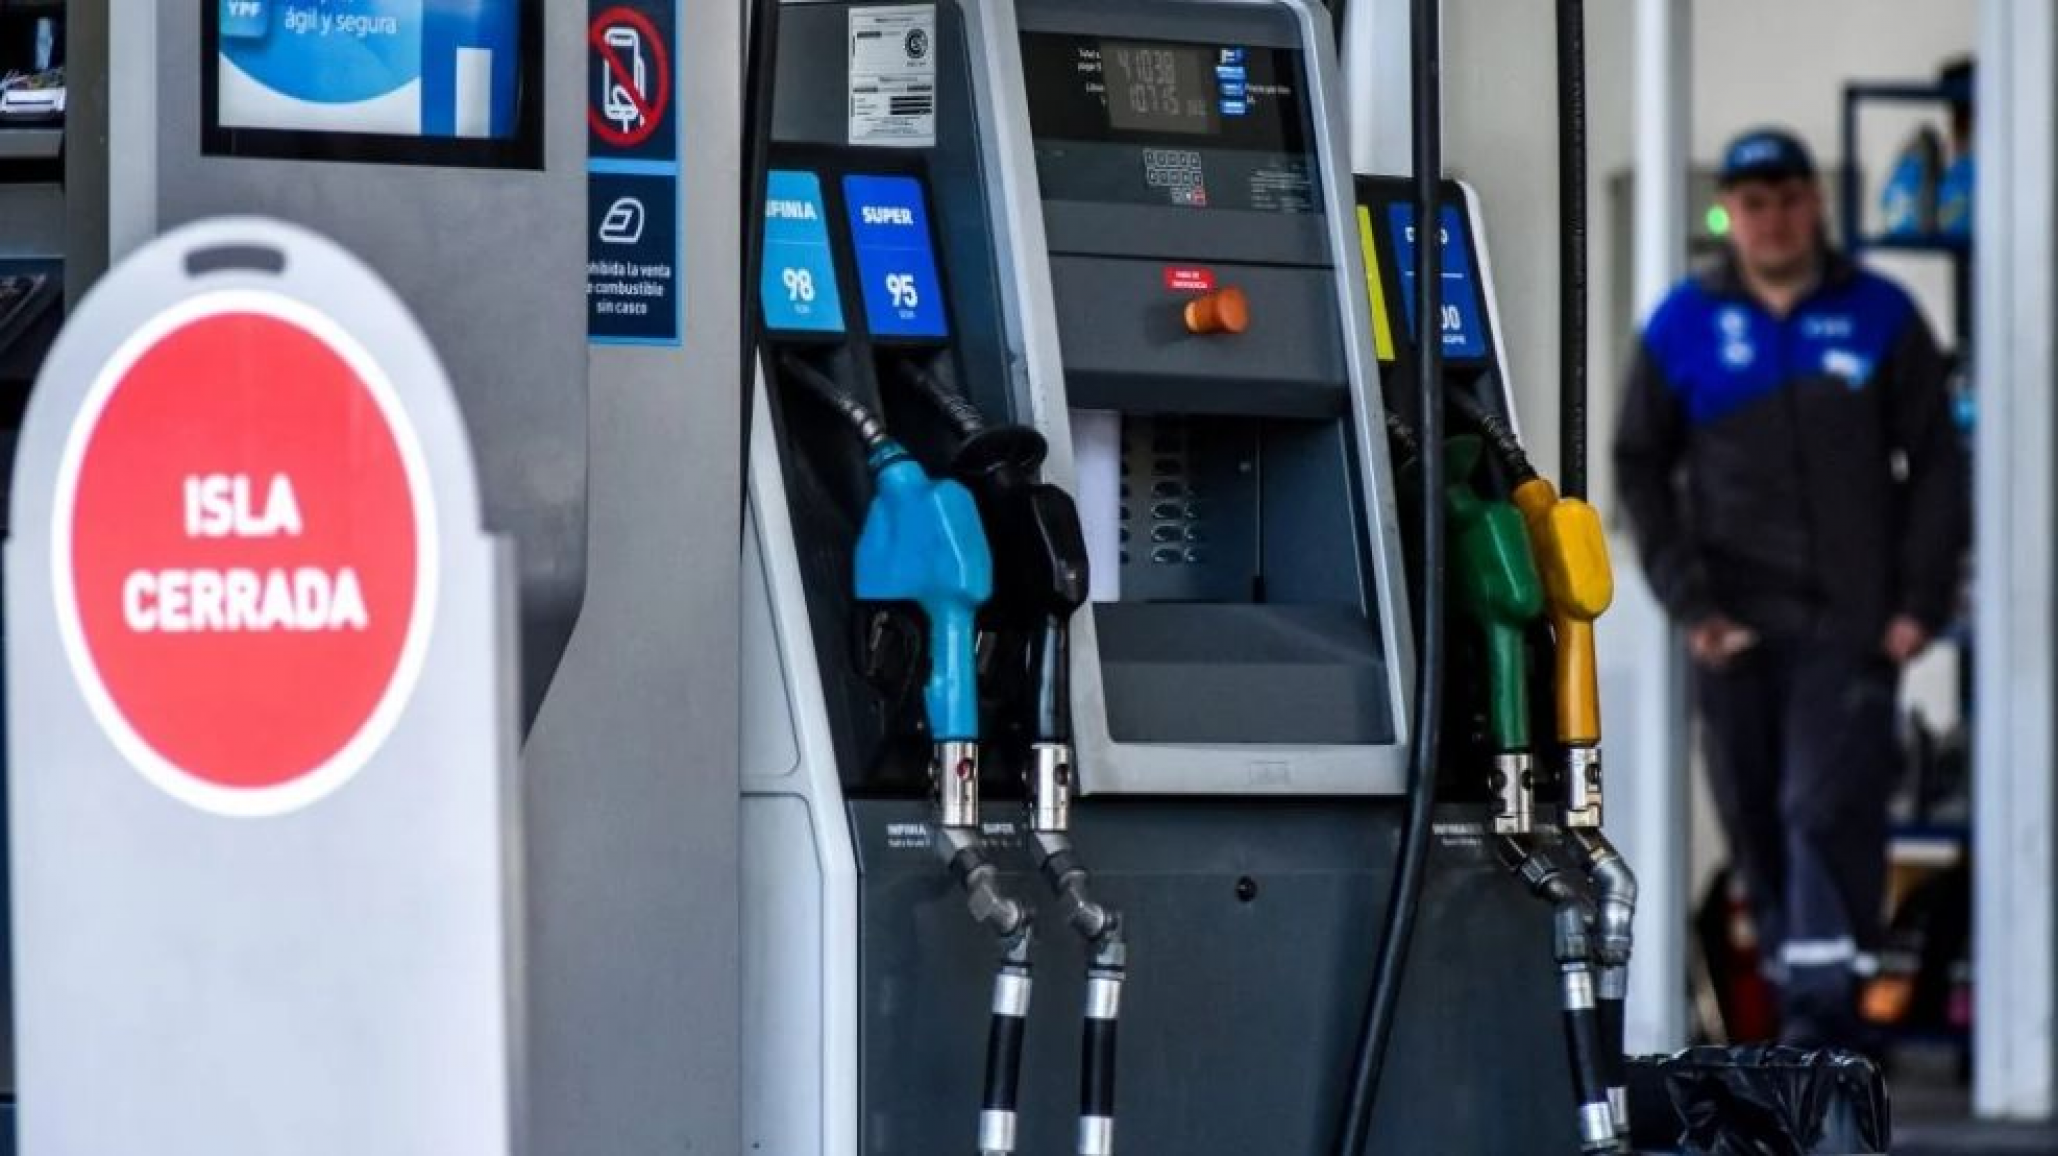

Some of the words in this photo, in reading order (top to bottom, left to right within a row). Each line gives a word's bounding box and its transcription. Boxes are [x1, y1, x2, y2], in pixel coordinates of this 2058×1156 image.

[285, 7, 318, 34] ágil
[320, 14, 332, 36] y
[336, 16, 398, 37] segura
[862, 206, 914, 225] SUPER
[627, 261, 639, 275] la
[641, 264, 671, 278] venta
[783, 267, 815, 301] 98
[596, 281, 664, 296] combustible
[886, 273, 918, 307] 95
[597, 302, 614, 313] sin
[615, 303, 648, 315] casco
[183, 472, 303, 539] ISLA
[122, 566, 370, 632] CERRADA
